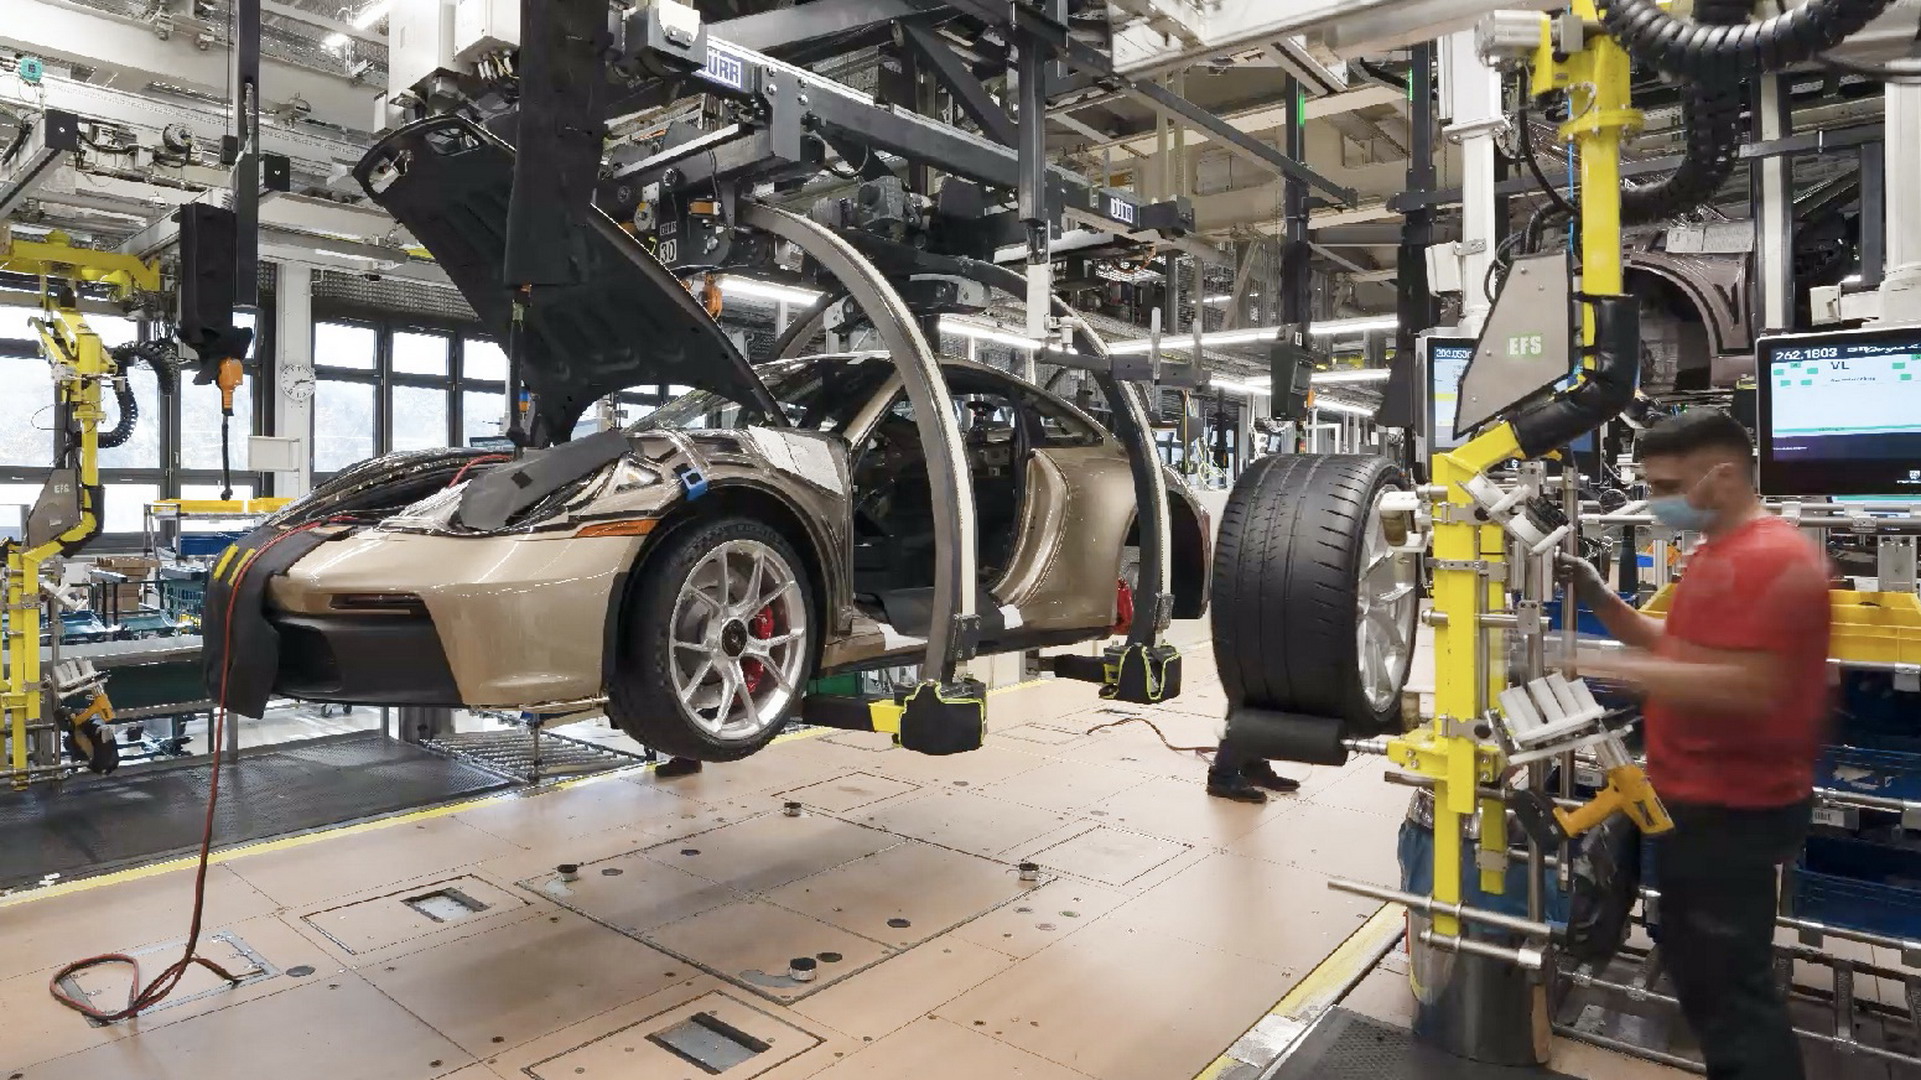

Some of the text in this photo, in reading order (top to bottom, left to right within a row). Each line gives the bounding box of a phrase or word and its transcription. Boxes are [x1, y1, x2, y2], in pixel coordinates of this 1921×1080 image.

[703, 48, 740, 85] ÜRR
[1509, 336, 1542, 355] EFS
[1775, 348, 1838, 361] 262.1803
